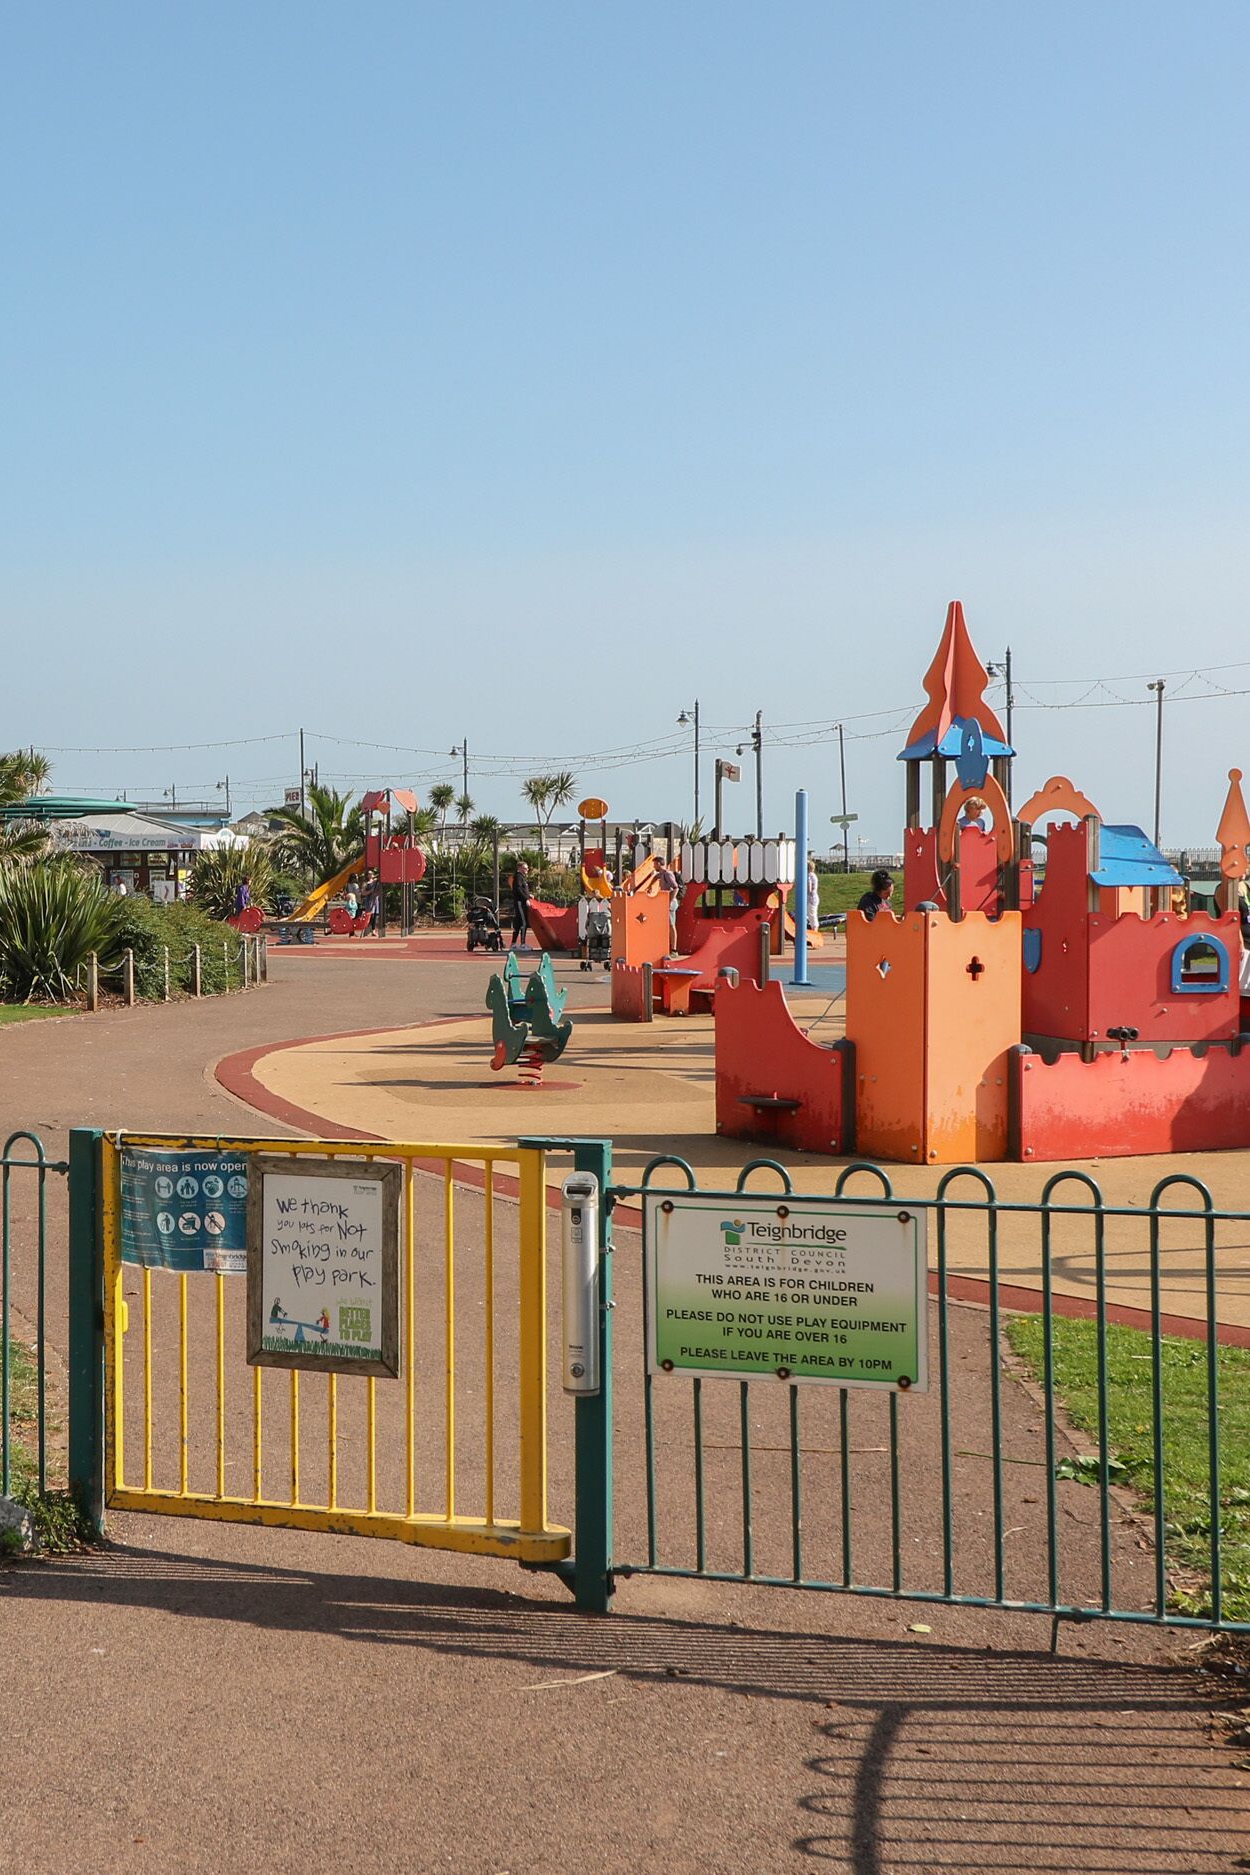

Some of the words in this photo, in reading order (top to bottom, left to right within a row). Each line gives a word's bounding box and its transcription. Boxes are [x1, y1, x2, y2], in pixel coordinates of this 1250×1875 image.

[99, 839, 122, 848] Coffee
[129, 838, 139, 846] Ice
[142, 838, 165, 846] Cream
[137, 1160, 154, 1172] play
[157, 1163, 178, 1172] area
[182, 1162, 190, 1172] is
[195, 1162, 217, 1170] now
[301, 1198, 348, 1219] thank
[277, 1219, 294, 1230] you
[299, 1221, 315, 1234] lots
[319, 1224, 334, 1234] for
[337, 1220, 367, 1242] Not
[747, 1222, 847, 1244] Teignbridge
[336, 1246, 346, 1258] in
[351, 1248, 374, 1260] our
[724, 1247, 781, 1255] DISTRICT
[791, 1250, 846, 1258] COUNCIL
[724, 1254, 775, 1263] South
[791, 1257, 846, 1267] Devon
[696, 1274, 723, 1285] THIS
[727, 1276, 760, 1287] AREA
[765, 1278, 776, 1287] IS
[780, 1279, 805, 1289] FOR
[809, 1280, 874, 1292] CHILDREN
[712, 1289, 741, 1300] WHO
[745, 1291, 770, 1302] ARE
[775, 1293, 787, 1303] 16
[791, 1293, 809, 1304] OR
[813, 1295, 858, 1306] UNDER
[666, 1310, 713, 1321] PLEASE
[717, 1312, 735, 1322] DO
[738, 1313, 764, 1324] NOT
[768, 1315, 792, 1326] USE
[796, 1317, 827, 1328] PLAY
[831, 1319, 907, 1333] EQUIPMENT
[723, 1327, 734, 1337] IF
[737, 1328, 763, 1339] YOU
[767, 1329, 791, 1340] ARE
[795, 1331, 829, 1343] OVER
[833, 1333, 847, 1344] 16
[680, 1348, 727, 1359] PLEASE
[731, 1350, 770, 1361] LEAVE
[773, 1352, 798, 1363] THE
[801, 1354, 835, 1366] AREA
[839, 1357, 855, 1367] BY
[859, 1358, 892, 1370] 10PM
